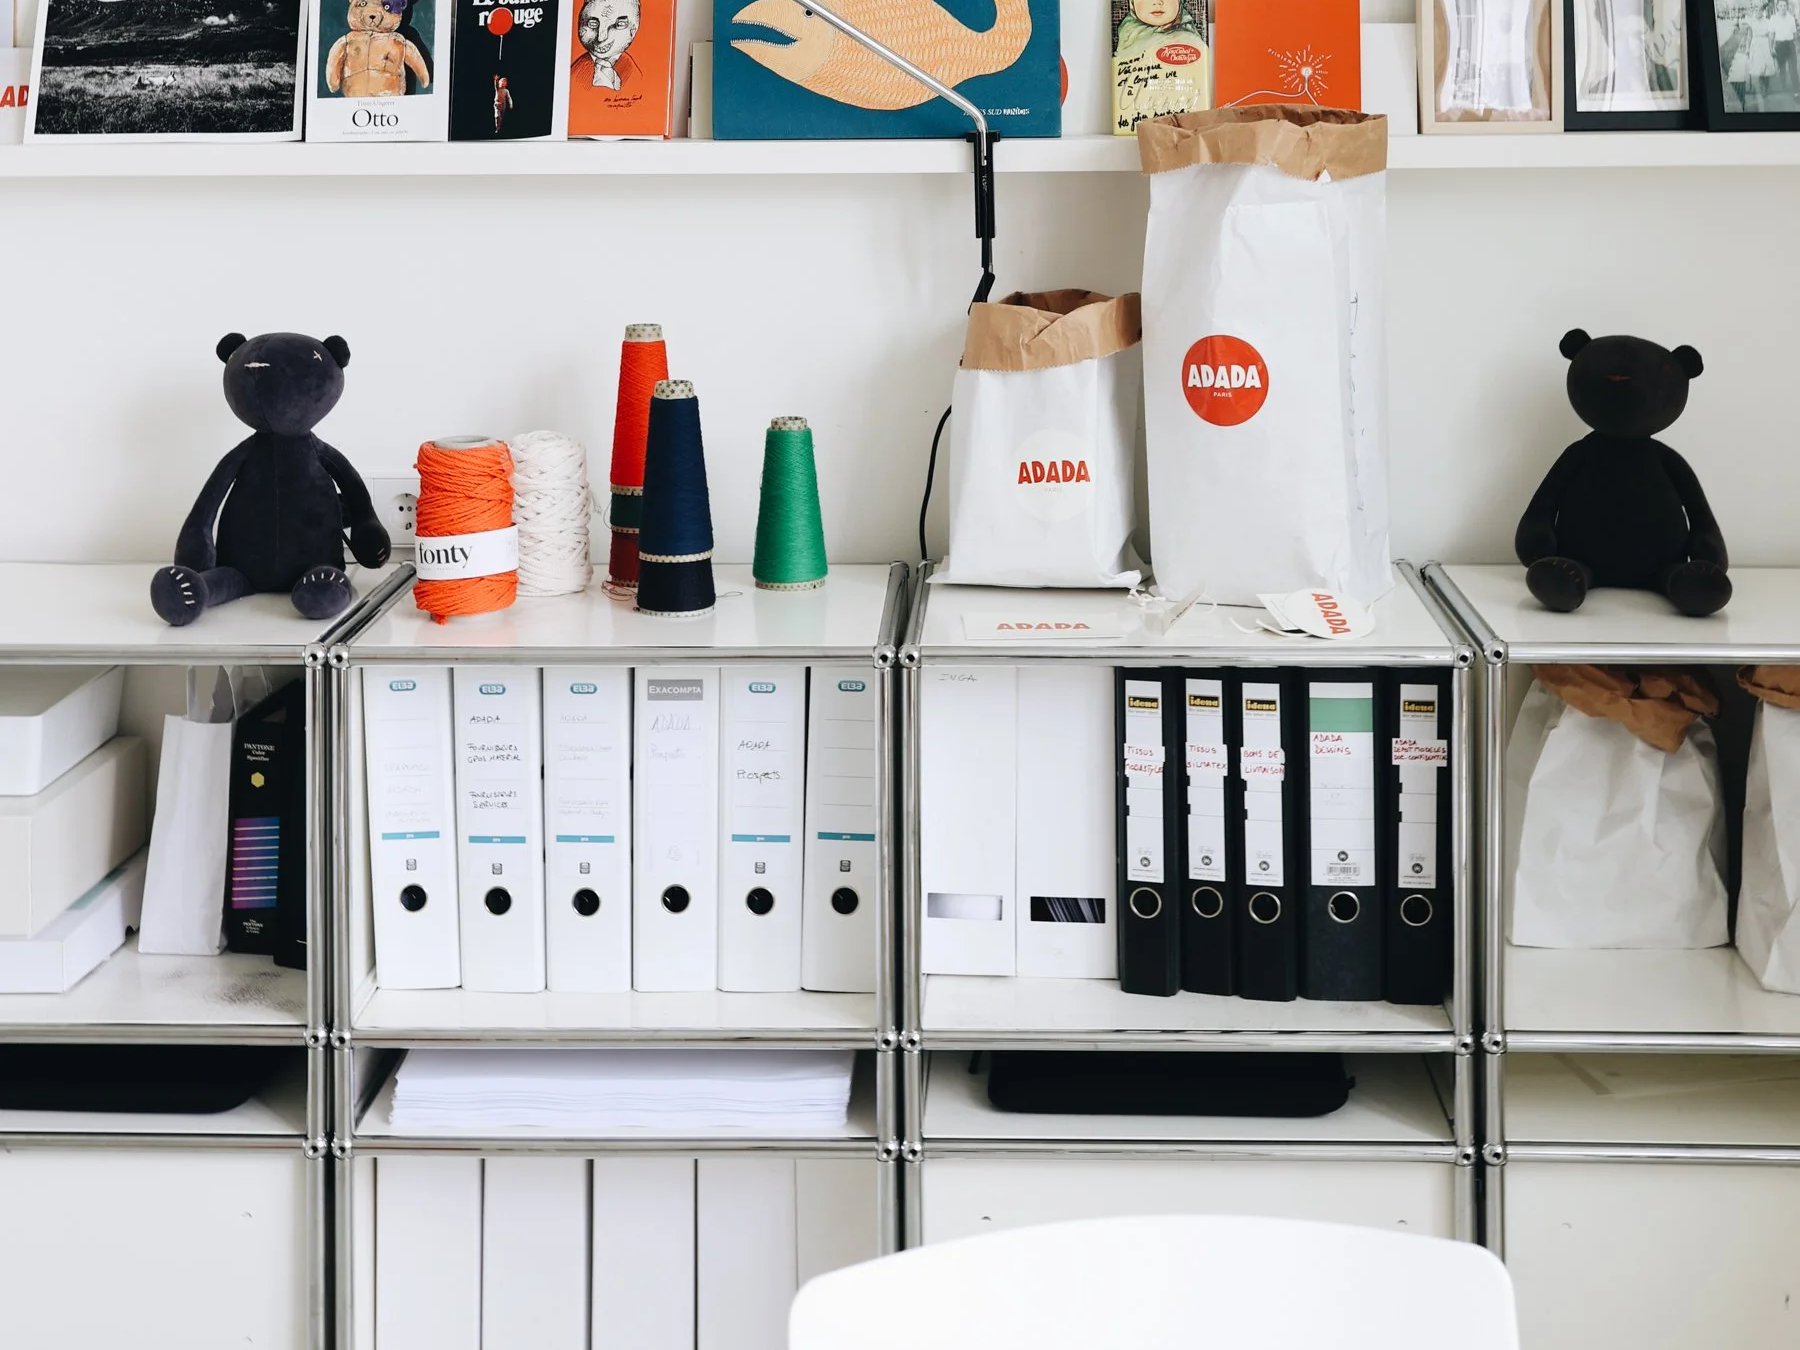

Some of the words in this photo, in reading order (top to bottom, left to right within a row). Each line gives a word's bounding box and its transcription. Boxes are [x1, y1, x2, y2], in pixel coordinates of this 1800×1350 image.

[1165, 70, 1178, 79] vie
[352, 109, 400, 128] Otto
[1187, 364, 1263, 389] ADADA
[1018, 460, 1091, 484] ADADA
[419, 542, 473, 569] fonty
[1311, 593, 1352, 635] ADADA
[1129, 697, 1158, 708] idena
[1190, 696, 1219, 707] idena
[1246, 701, 1276, 710] idena
[1404, 702, 1434, 711] idena
[1313, 734, 1343, 742] ADADA
